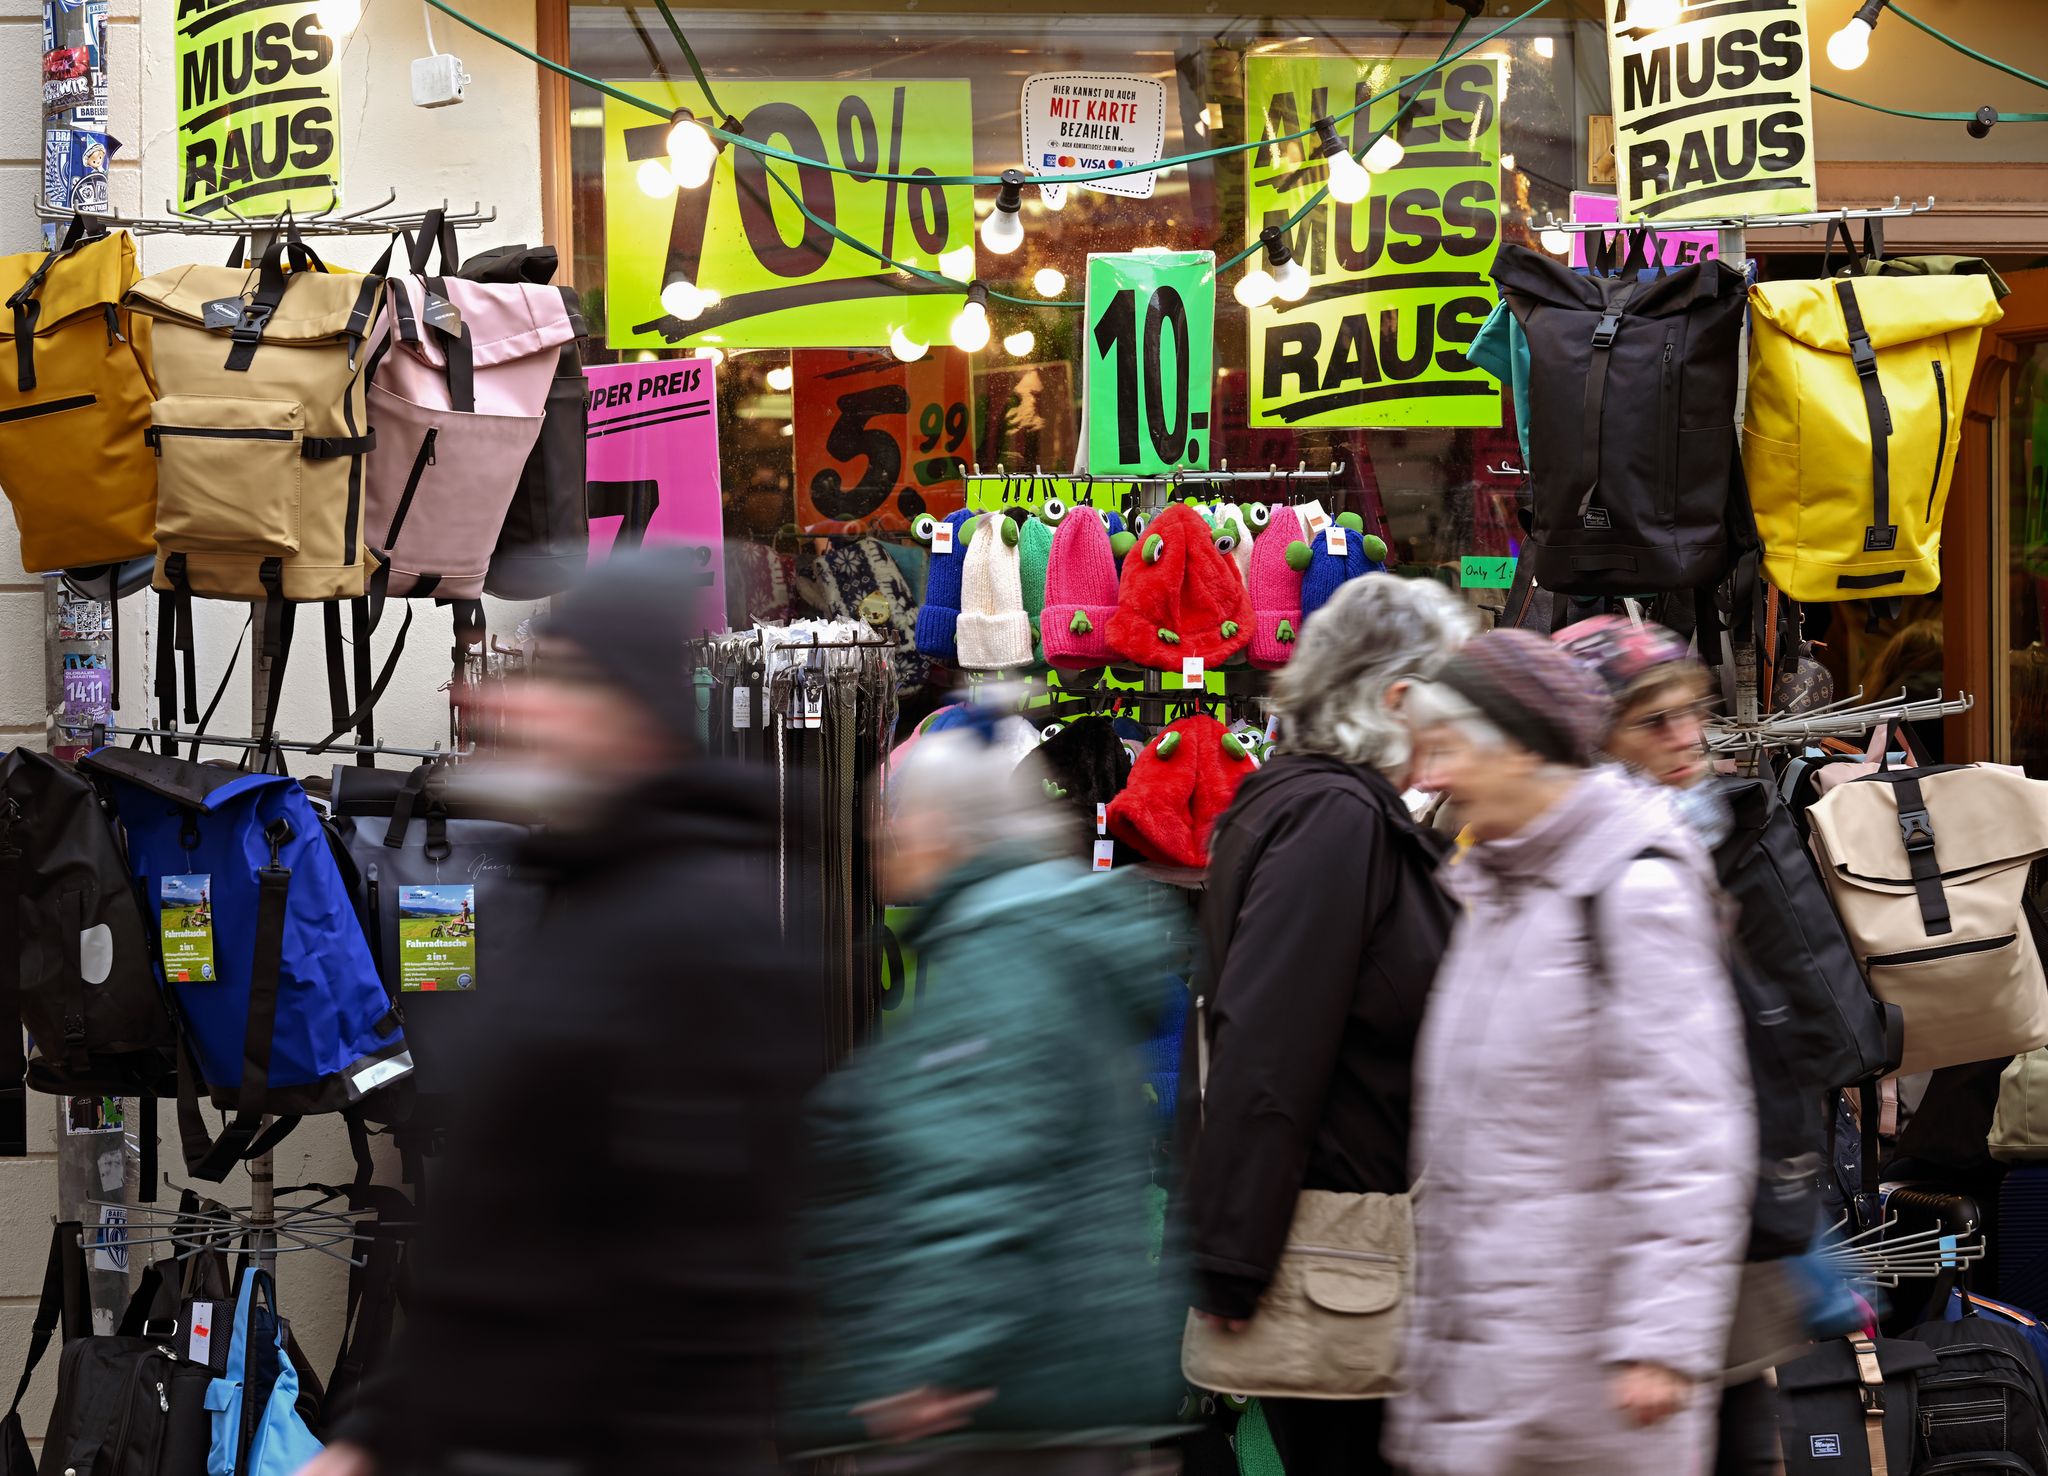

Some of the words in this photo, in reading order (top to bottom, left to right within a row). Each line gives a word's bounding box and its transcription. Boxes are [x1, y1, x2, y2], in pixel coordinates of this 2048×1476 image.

[183, 13, 333, 111] MUSS
[1623, 20, 1803, 112] MUSS
[1053, 85, 1070, 95] HIER
[1073, 86, 1101, 98] KANNST
[1104, 89, 1114, 99] DU
[1117, 90, 1136, 100] AUCH
[1050, 97, 1080, 119] MIT
[1086, 100, 1138, 124] KARTE
[1254, 64, 1493, 168] ALLES
[1060, 121, 1123, 141] BEZAHLEN.
[183, 107, 334, 202] RAUS
[1079, 158, 1106, 169] VISA
[1629, 111, 1806, 201] RAUS
[624, 87, 949, 297] 70%
[1262, 180, 1496, 278] MUSS
[1263, 296, 1492, 399] RAUS
[637, 367, 702, 401] PREIS
[1466, 564, 1488, 580] Only
[66, 680, 106, 703] 14.11.
[406, 939, 467, 948] Fahrradtasche
[433, 952, 442, 960] in
